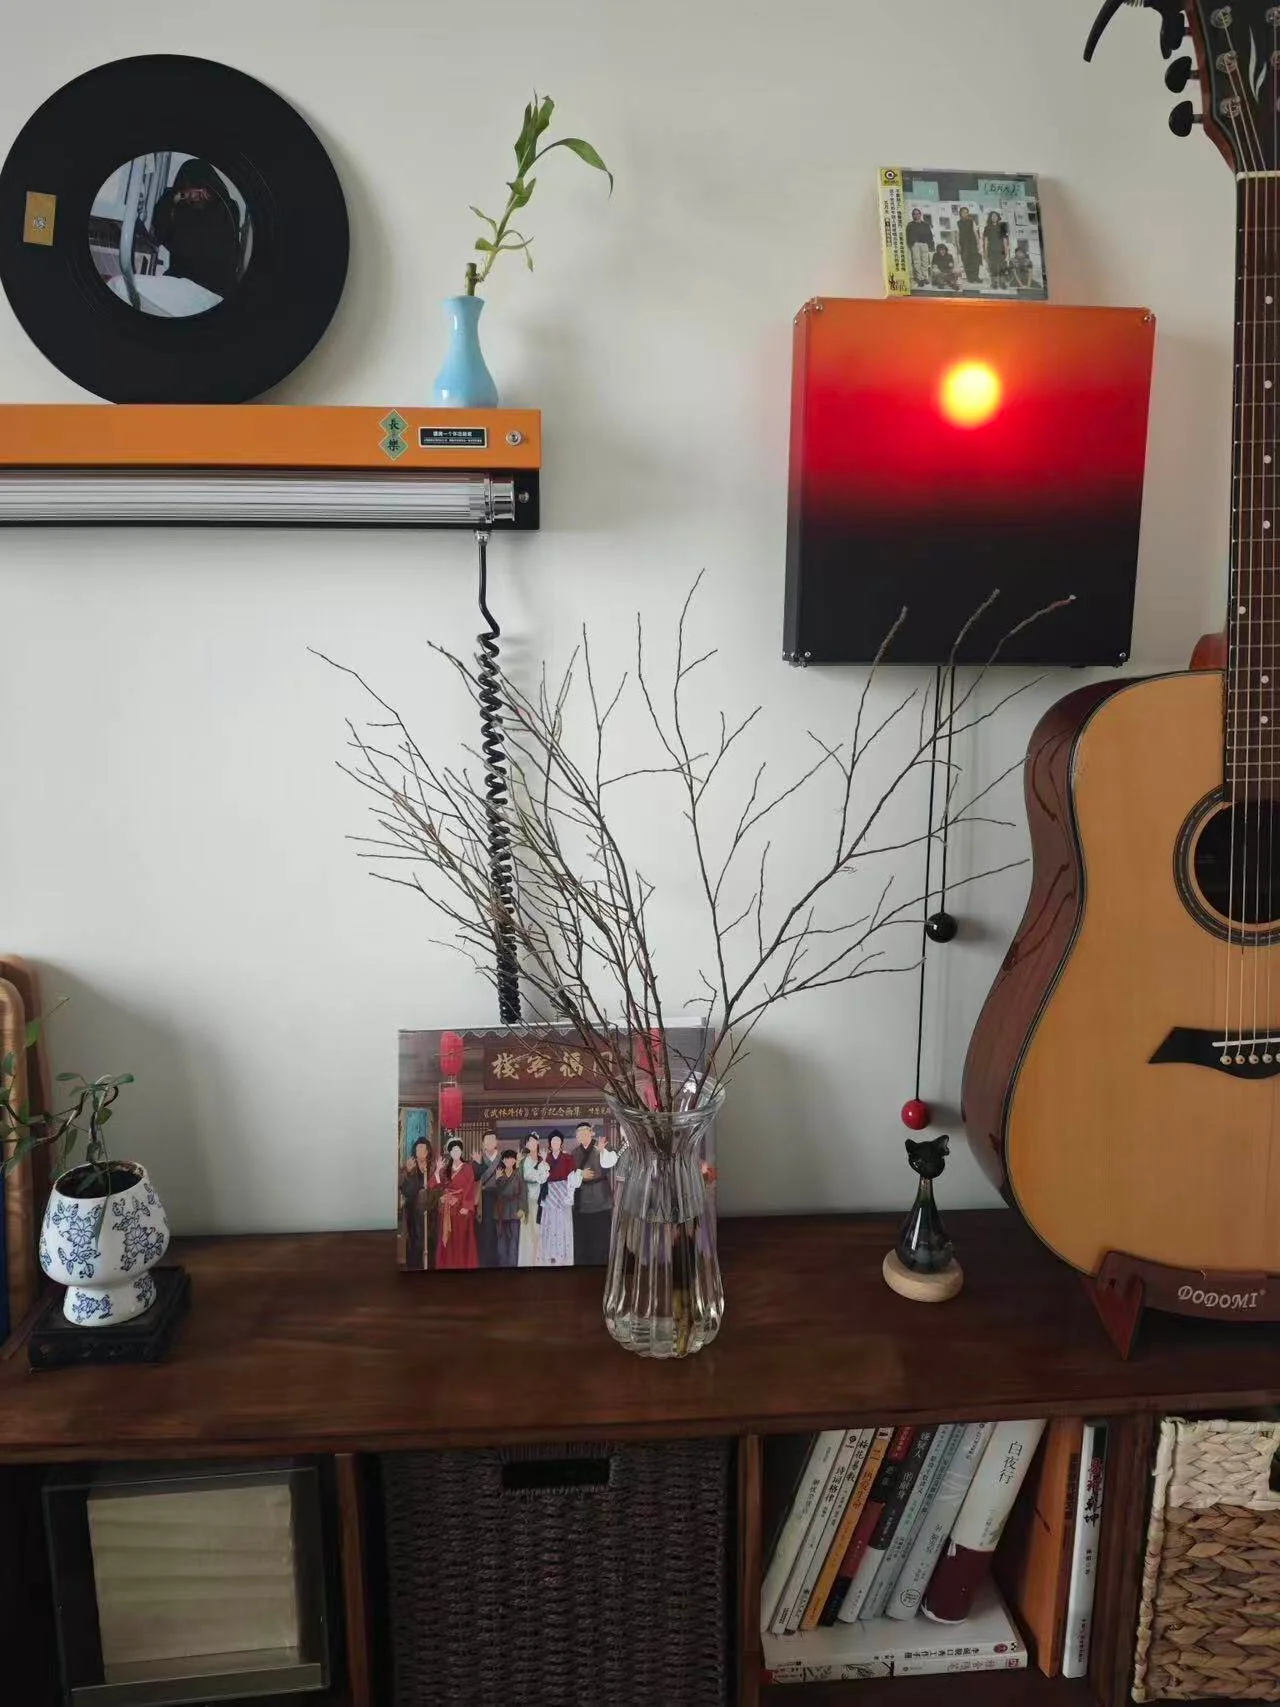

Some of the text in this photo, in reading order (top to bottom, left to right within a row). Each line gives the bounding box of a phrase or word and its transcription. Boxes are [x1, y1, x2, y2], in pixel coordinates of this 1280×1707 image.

[1177, 1285, 1259, 1309] DODOMI
[998, 1441, 1024, 1485] 白夜行
[823, 1465, 846, 1504] 诗词格律
